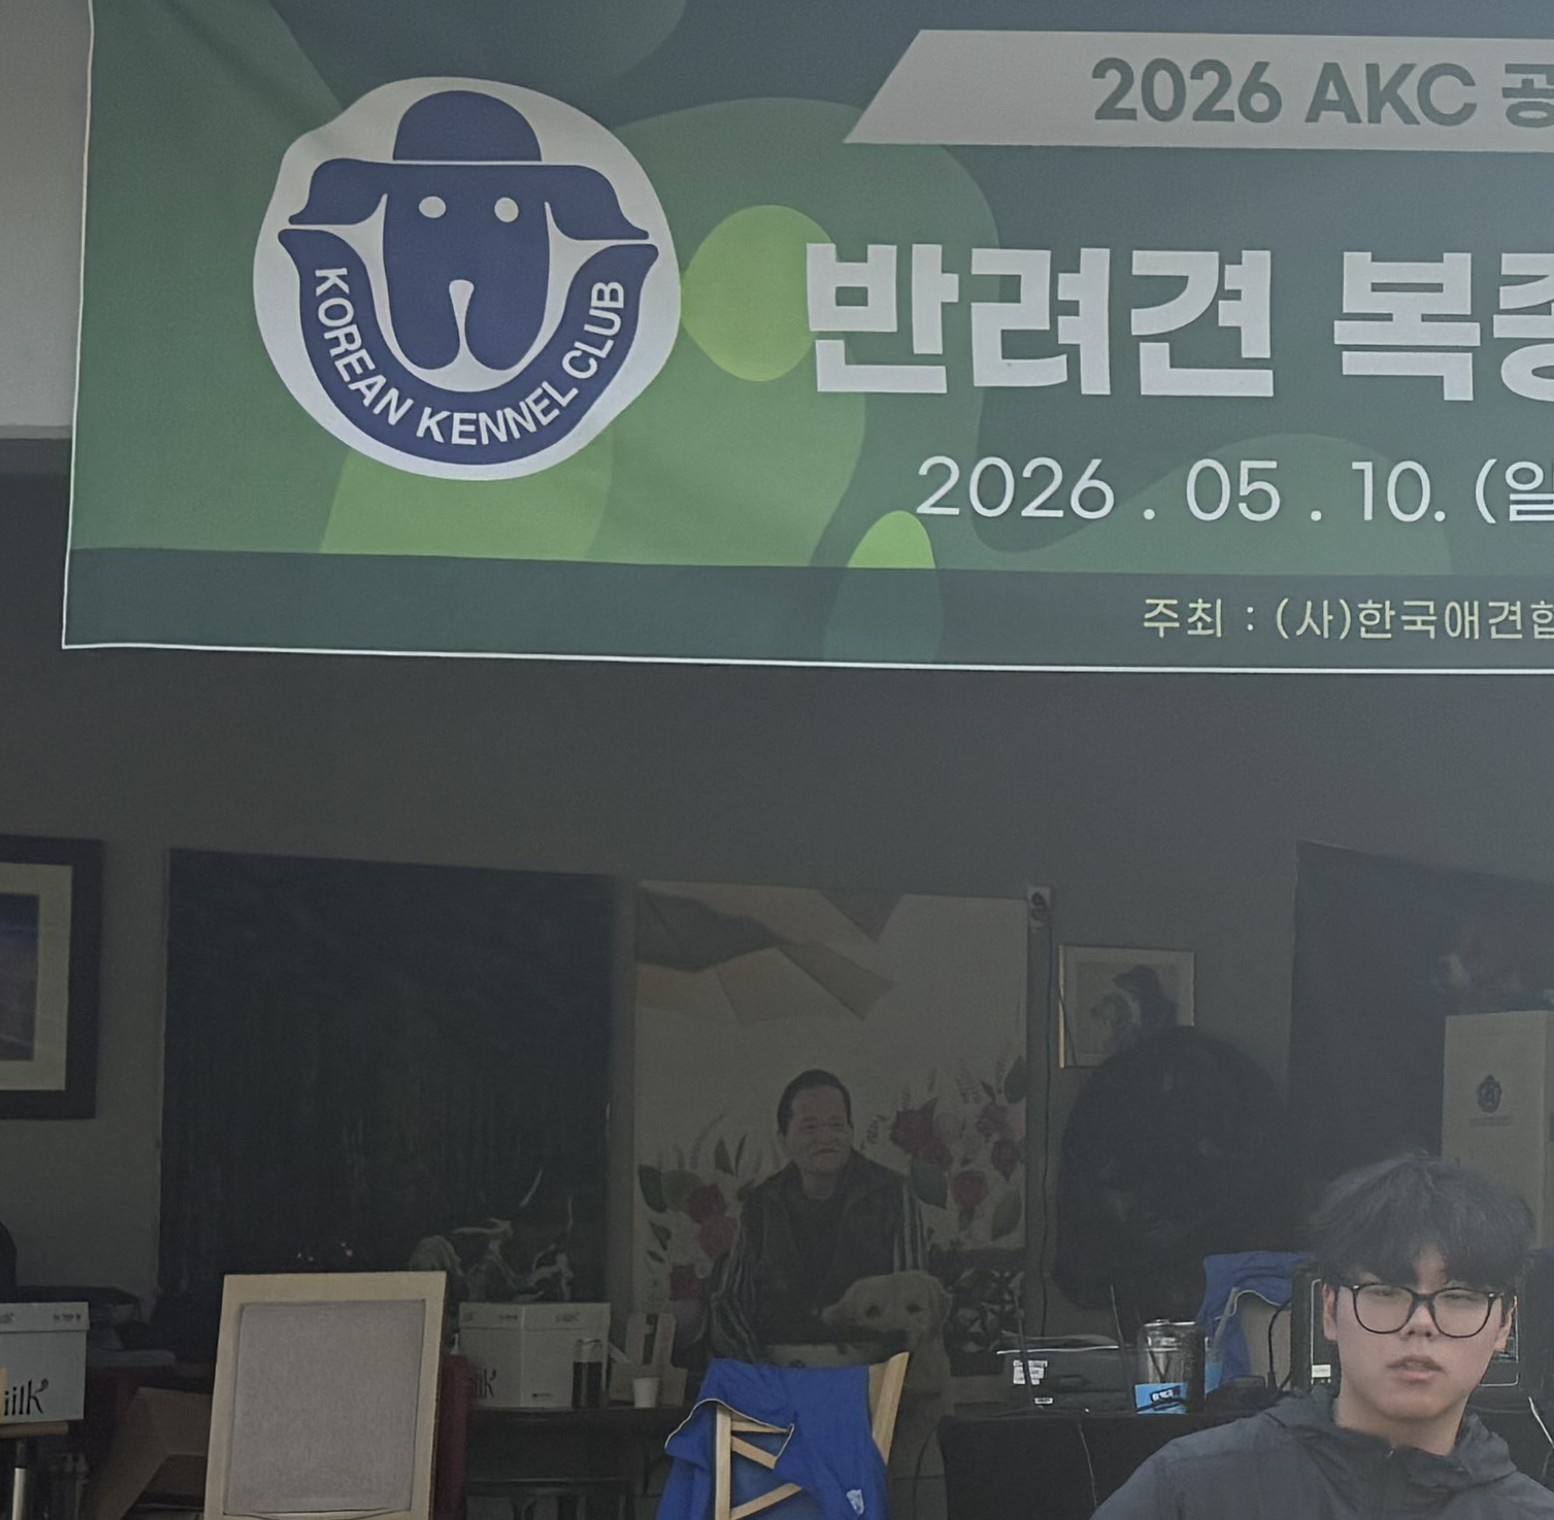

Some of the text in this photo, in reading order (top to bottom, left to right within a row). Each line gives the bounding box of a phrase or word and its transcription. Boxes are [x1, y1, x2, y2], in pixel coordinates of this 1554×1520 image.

[1092, 57, 1283, 125] 2026
[1304, 62, 1477, 127] AKC
[805, 242, 1275, 398] 반려견
[313, 264, 626, 447] KOREAN KENNEL CLUB
[917, 455, 1116, 520] 2026
[1186, 459, 1281, 523] 05
[1142, 596, 1225, 641] 주최
